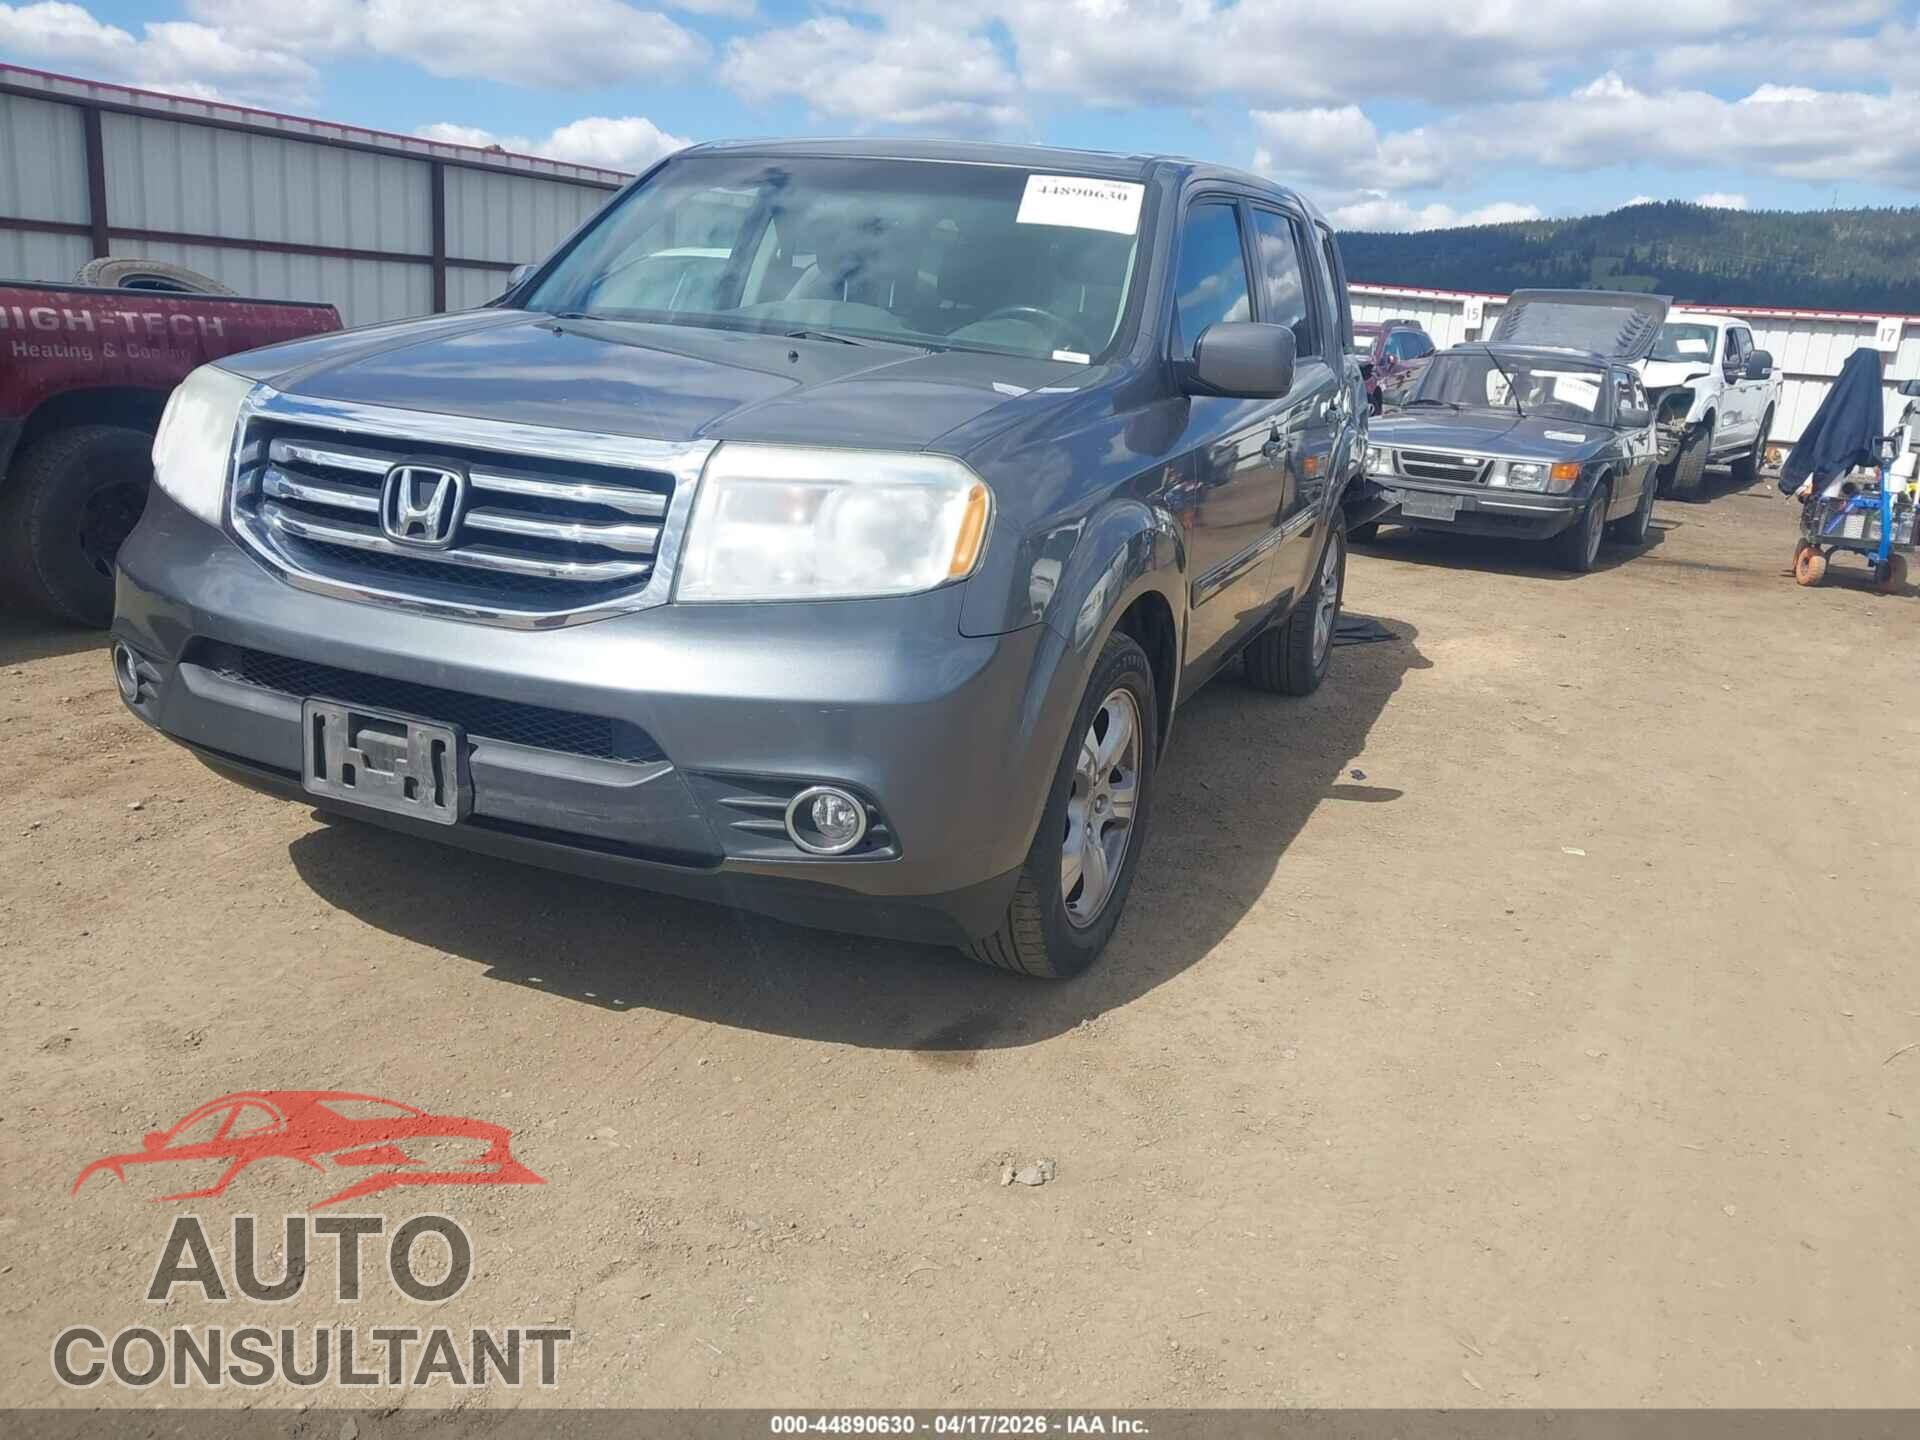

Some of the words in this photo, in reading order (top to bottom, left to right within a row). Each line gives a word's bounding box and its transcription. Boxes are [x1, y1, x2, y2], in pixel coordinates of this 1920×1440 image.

[0, 306, 224, 337] IGH-TECH
[1467, 307, 1480, 321] 15
[1881, 328, 1897, 344] 17
[11, 340, 94, 361] Heating
[103, 342, 118, 359] &
